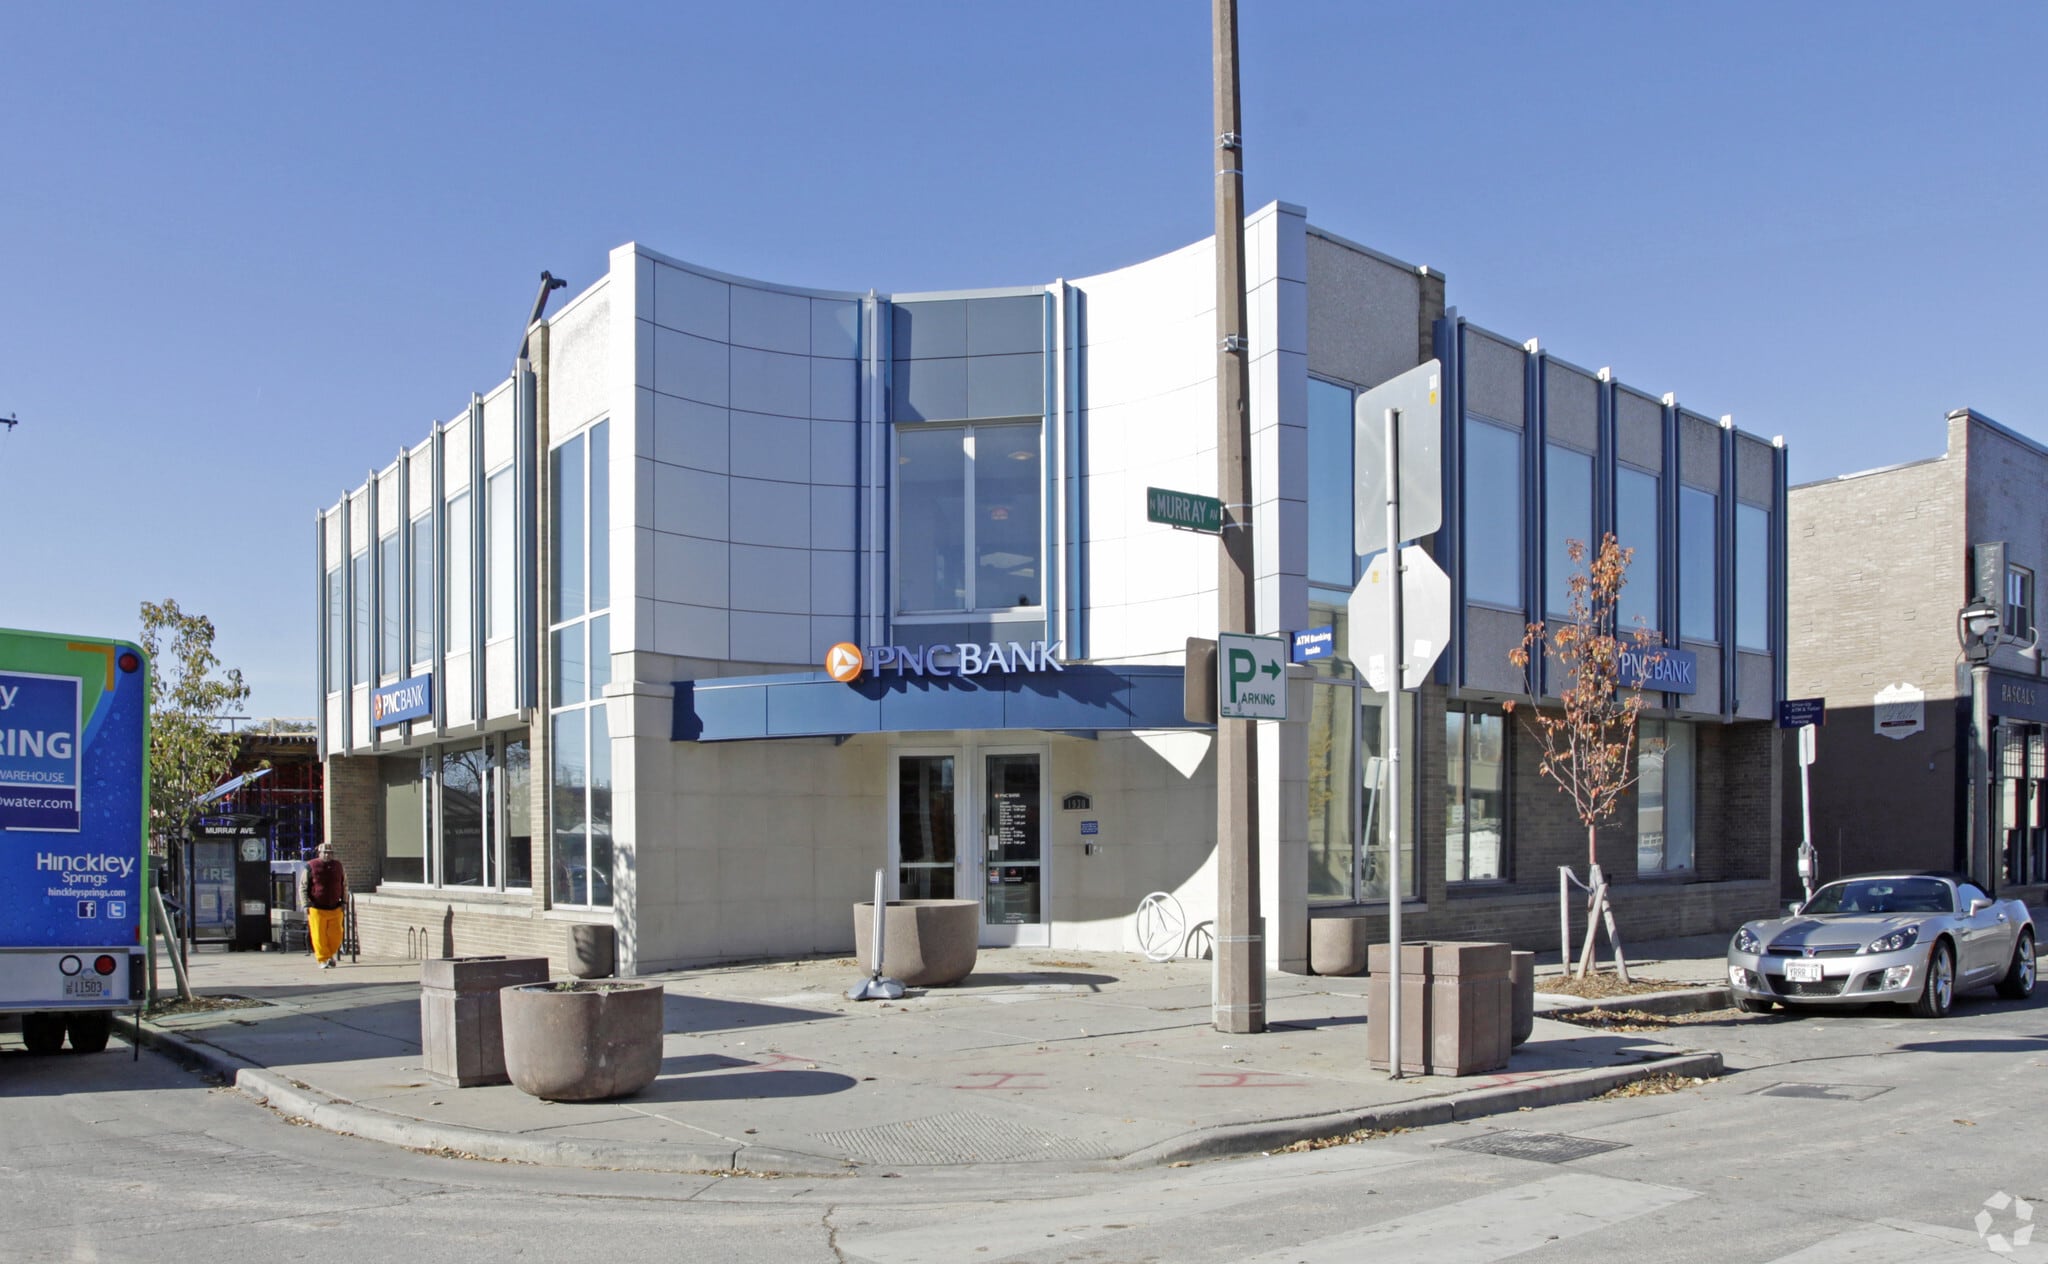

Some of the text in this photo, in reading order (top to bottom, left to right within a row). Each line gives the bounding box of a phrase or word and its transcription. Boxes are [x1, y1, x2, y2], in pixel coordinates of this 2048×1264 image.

[1157, 493, 1207, 524] MURRAY
[1296, 632, 1332, 647] ATM Banking
[1305, 645, 1321, 657] Inside
[2001, 684, 2036, 706] RASCALS
[0, 728, 72, 759] ING
[37, 851, 136, 878] Hinckley
[61, 871, 109, 887] Springs
[48, 887, 126, 900] hinckleysprings.com
[75, 980, 103, 994] 11503
